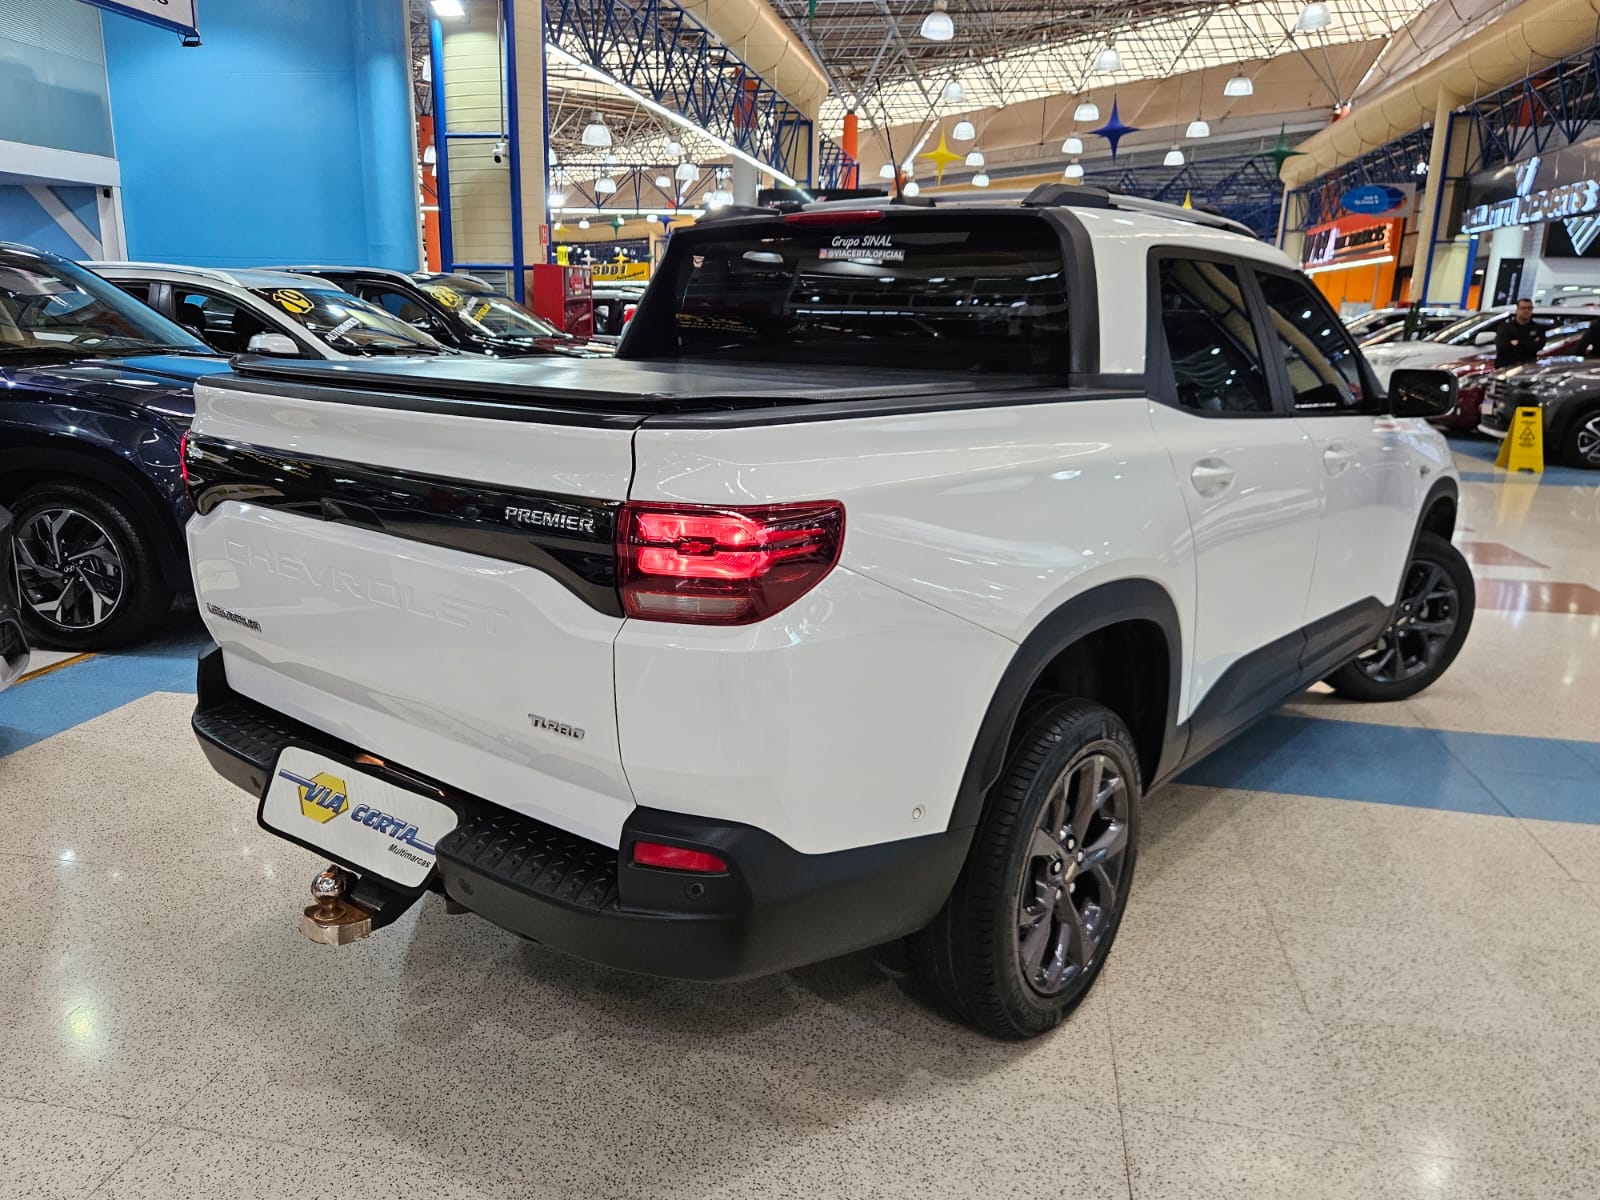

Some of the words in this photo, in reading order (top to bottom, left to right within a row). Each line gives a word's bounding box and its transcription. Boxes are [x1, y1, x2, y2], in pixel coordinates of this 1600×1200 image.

[827, 249, 904, 259] @VIACERTA.OFICIAL
[831, 235, 860, 249] Grupo
[861, 234, 892, 247] SINAL
[593, 265, 627, 276] 3001
[505, 506, 594, 533] PREMIER
[223, 537, 510, 634] CHEVROLET
[527, 713, 585, 740] TURBO
[304, 785, 347, 814] VIA
[350, 804, 419, 843] CERTA
[388, 844, 432, 868] Multimarcas
